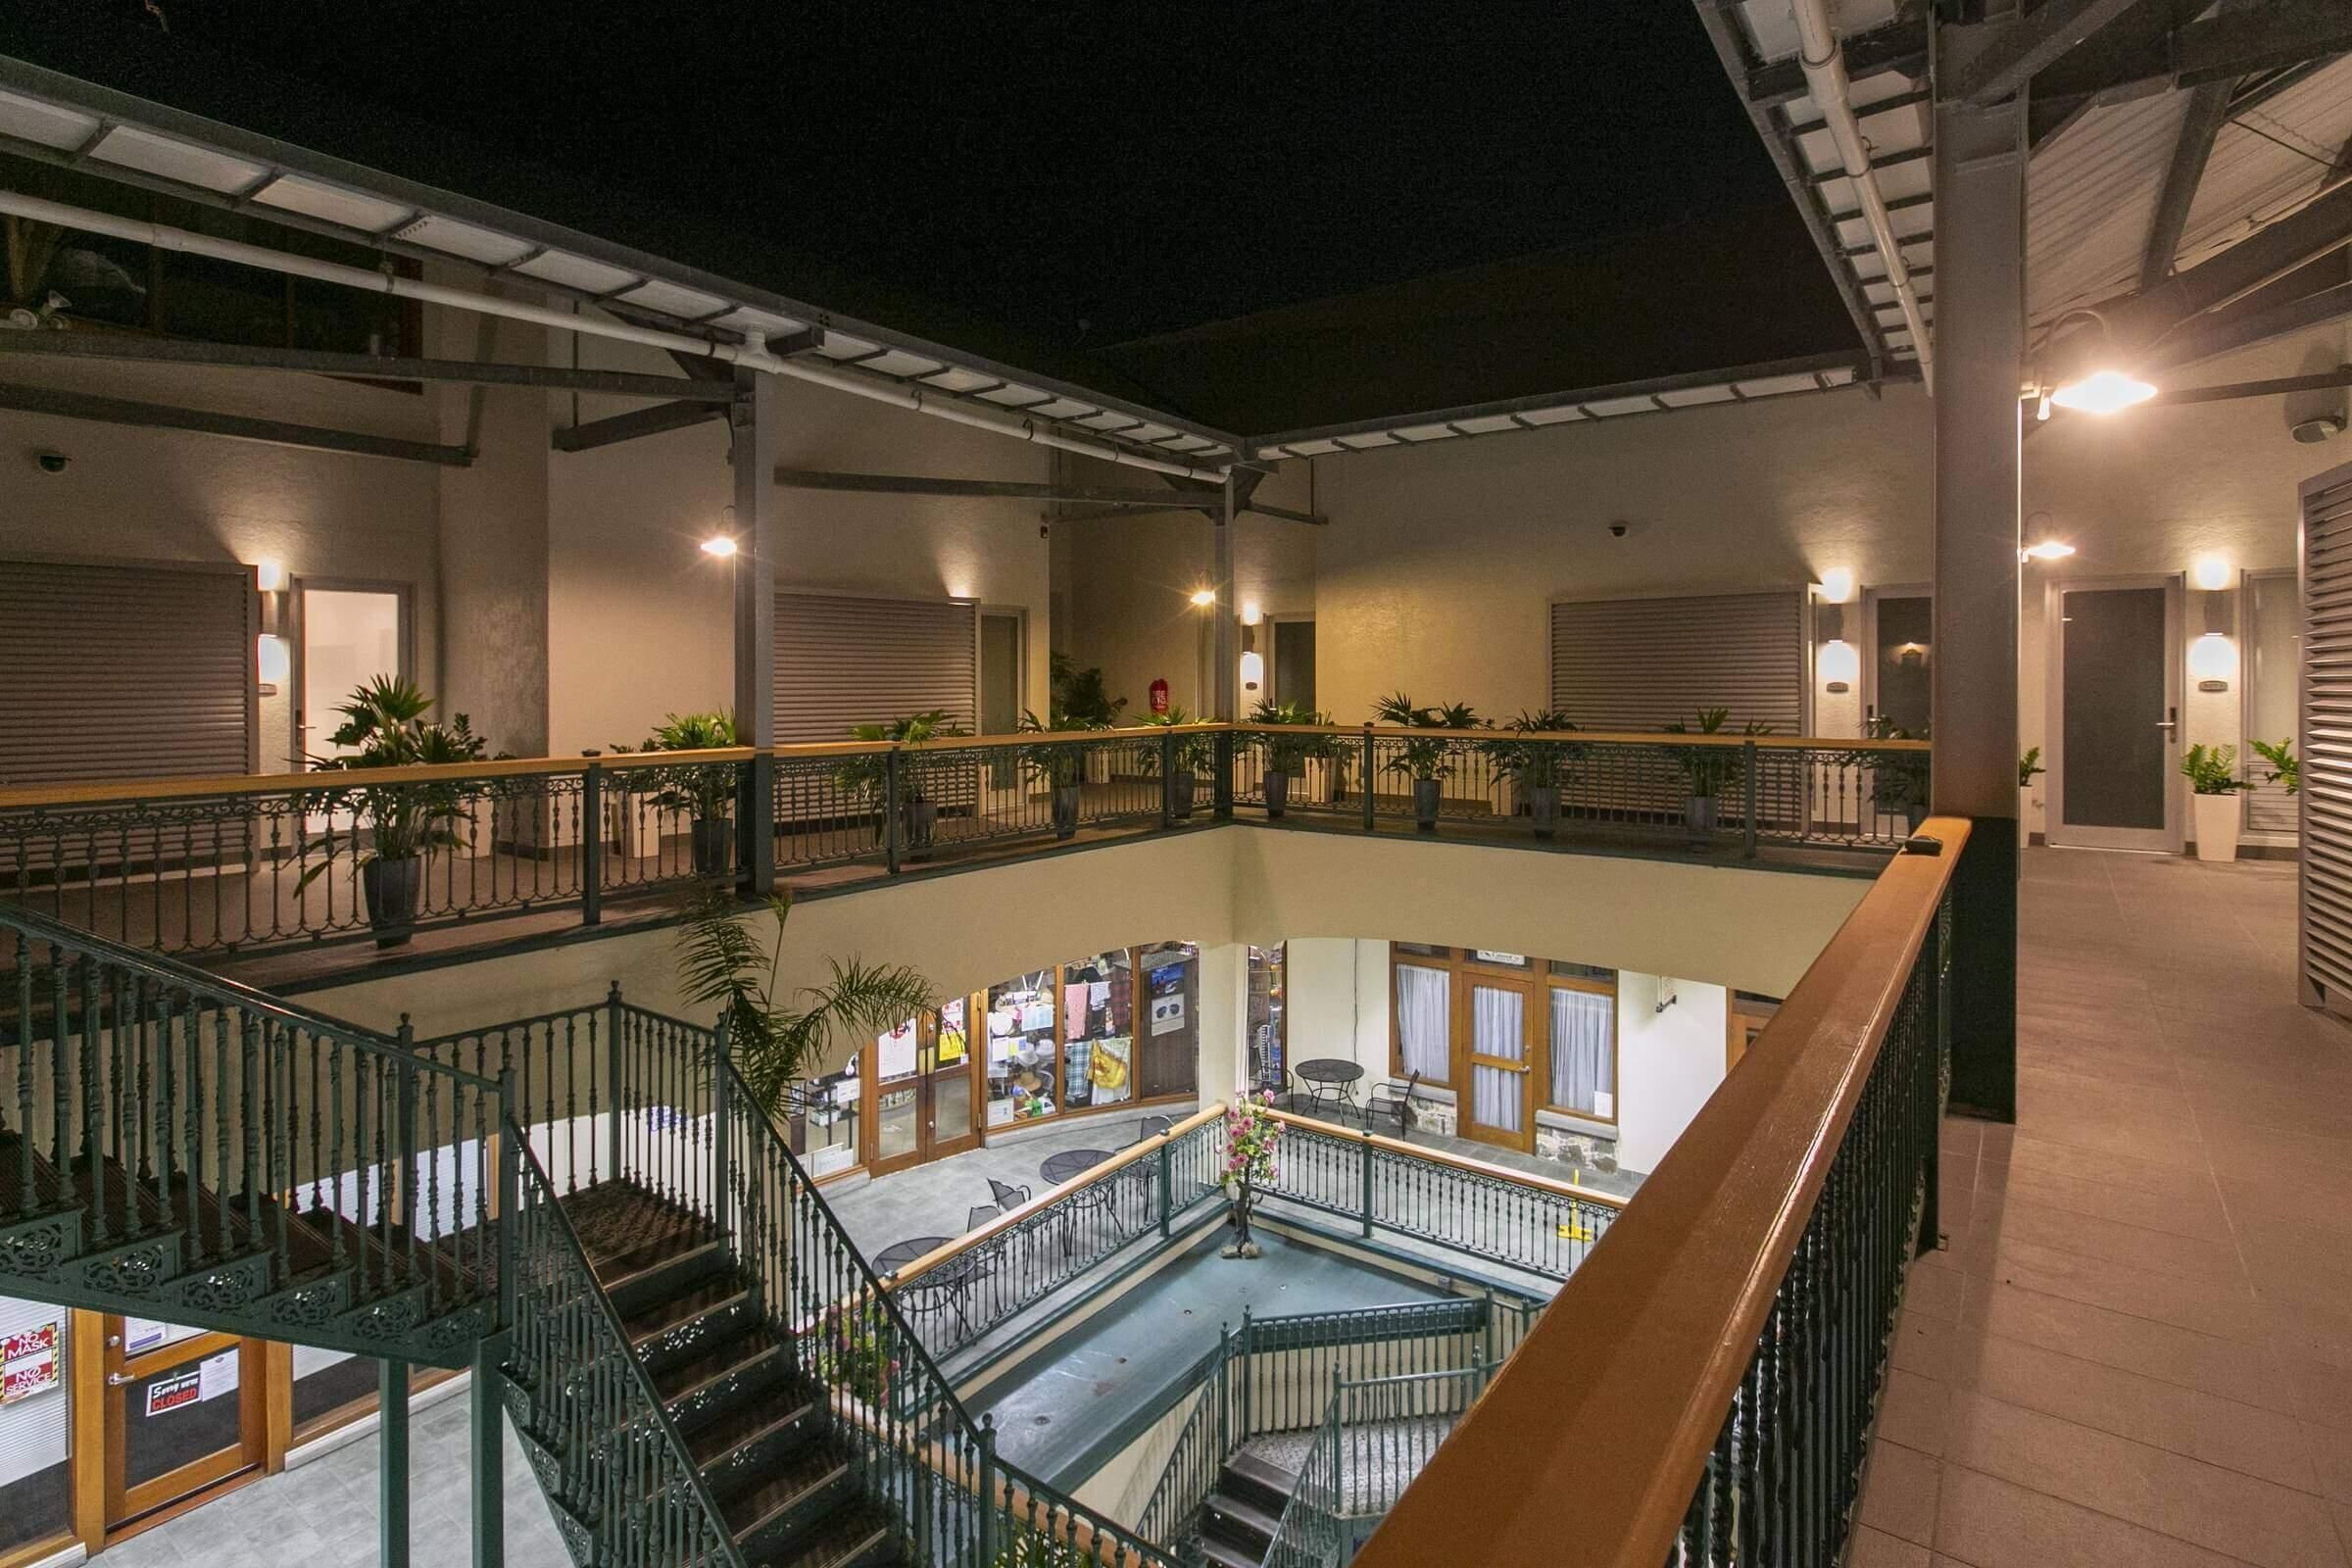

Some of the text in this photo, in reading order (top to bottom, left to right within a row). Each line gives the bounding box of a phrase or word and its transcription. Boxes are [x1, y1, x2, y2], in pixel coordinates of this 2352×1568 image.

[7, 1337, 51, 1359] MASK
[19, 1333, 39, 1348] NO
[6, 1372, 52, 1396] SERVICE
[16, 1367, 41, 1384] NO
[152, 1387, 198, 1411] CLOSED
